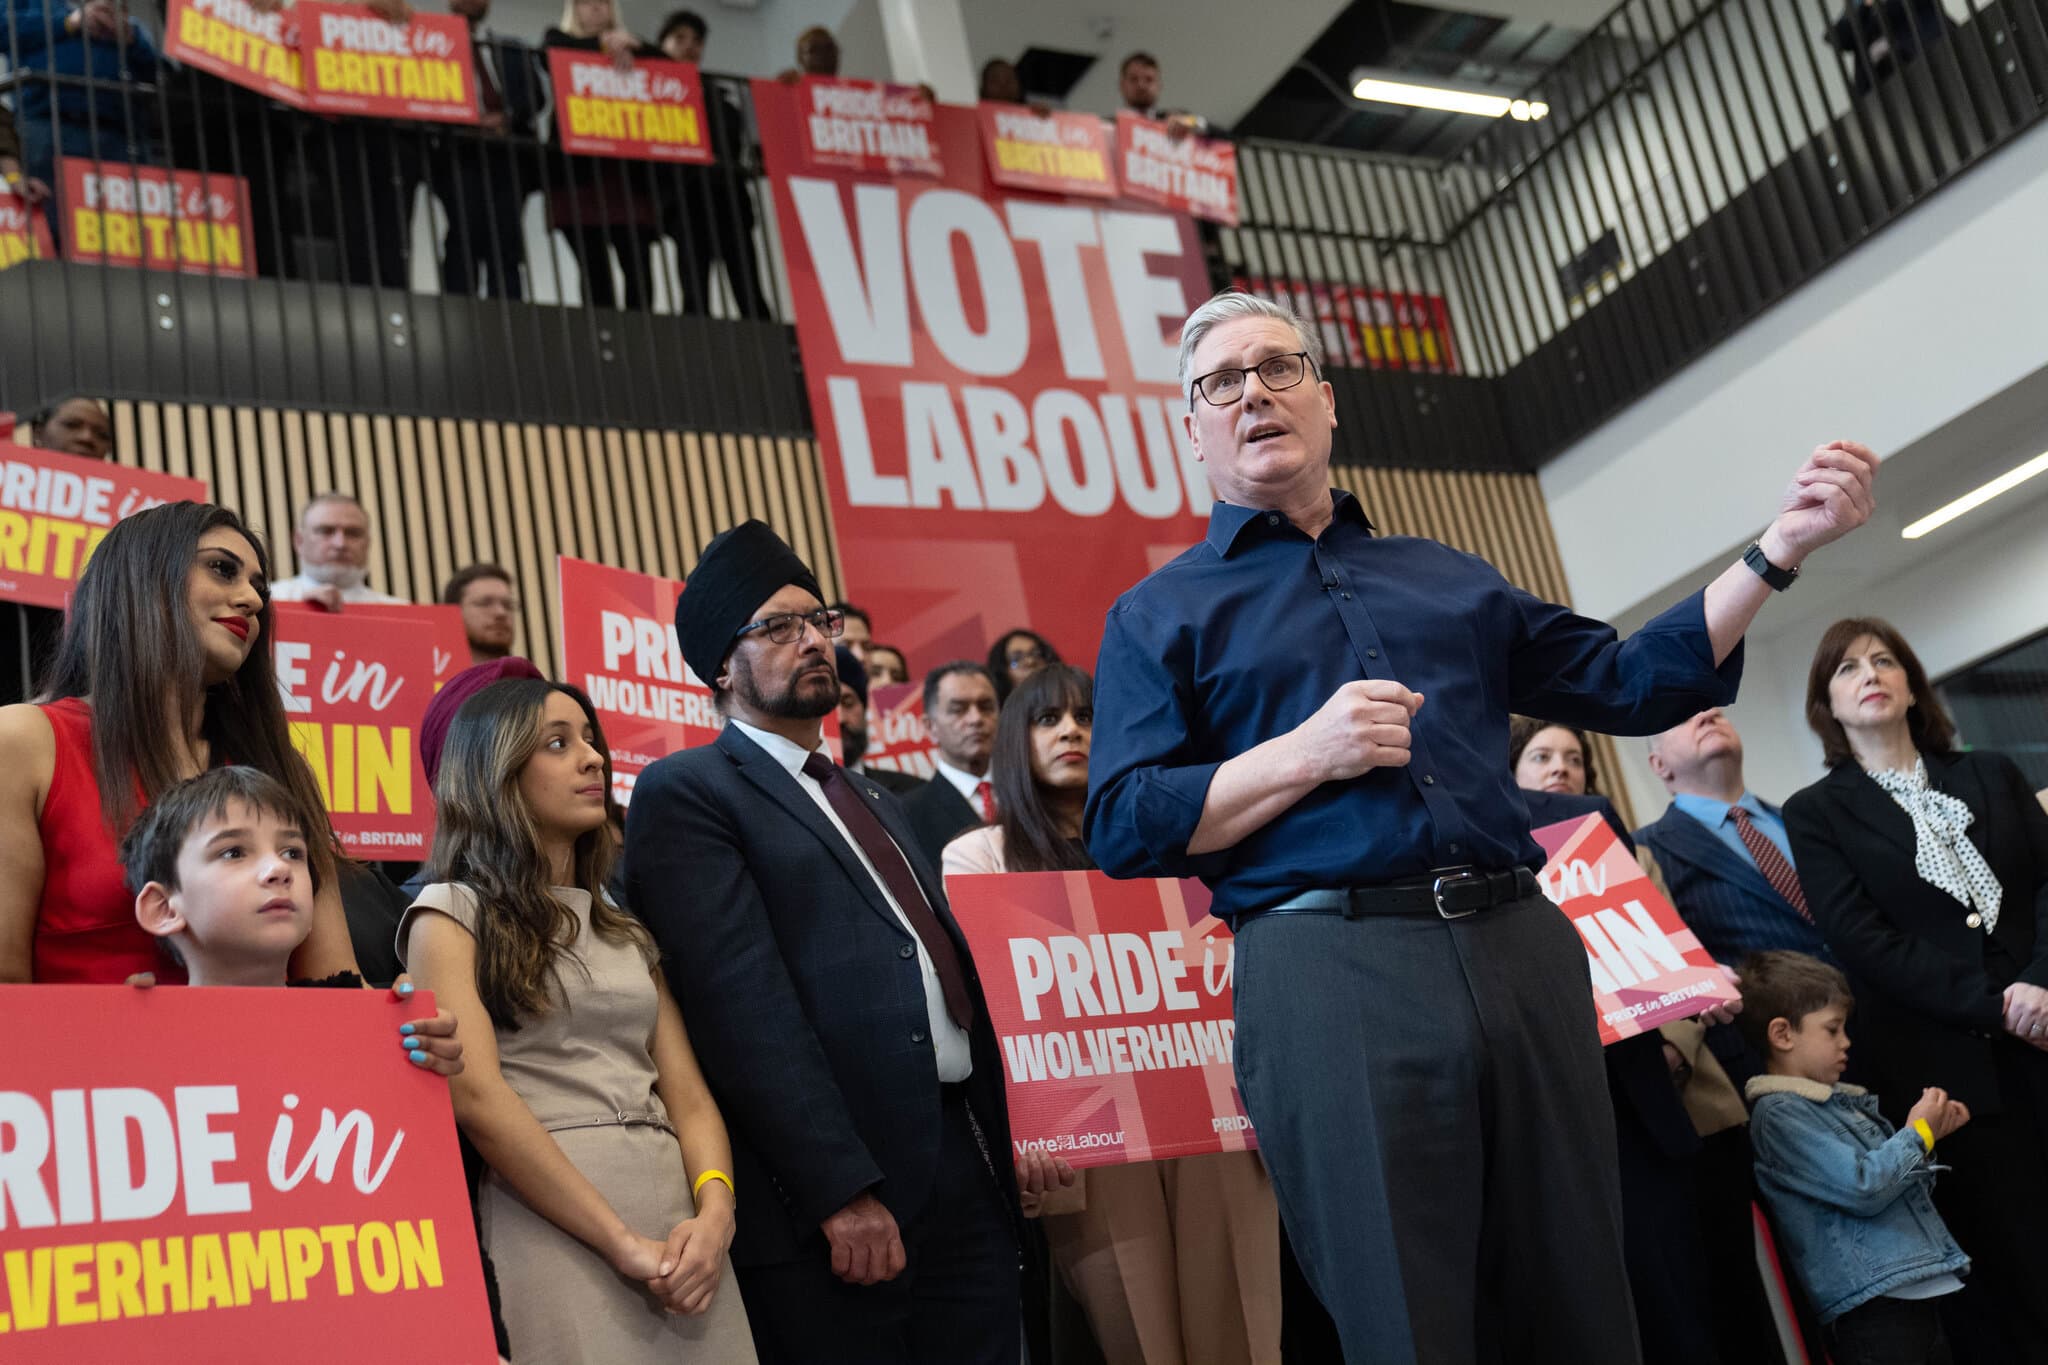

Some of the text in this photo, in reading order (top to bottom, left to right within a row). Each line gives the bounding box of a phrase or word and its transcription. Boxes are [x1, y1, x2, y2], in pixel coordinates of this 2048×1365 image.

[180, 5, 307, 92] BRITAI
[320, 12, 455, 58] PRIDE in
[314, 48, 465, 103] BRITAIN
[570, 62, 689, 103] PRIDE in
[567, 95, 700, 145] BRITAIN
[808, 114, 932, 161] BRITAIN
[994, 138, 1107, 184] BRITAIN
[1126, 150, 1228, 211] BRITAIN
[74, 207, 243, 268] BRITAIN
[789, 176, 1184, 384] VOTE
[0, 459, 115, 526] RIDE
[601, 609, 709, 688] PRI
[321, 650, 404, 711] in
[584, 673, 727, 731] WOLVERH
[360, 831, 423, 847] BRITAIN
[1008, 930, 1201, 1022] PRIDE
[1602, 978, 1719, 1026] PRIDE in BRITAIN
[1002, 1018, 1236, 1084] WOLVERHAMP
[0, 1085, 405, 1231] RIDE in
[1014, 1131, 1125, 1156] Vote Labour
[0, 1219, 443, 1335] VERHAMPTON
